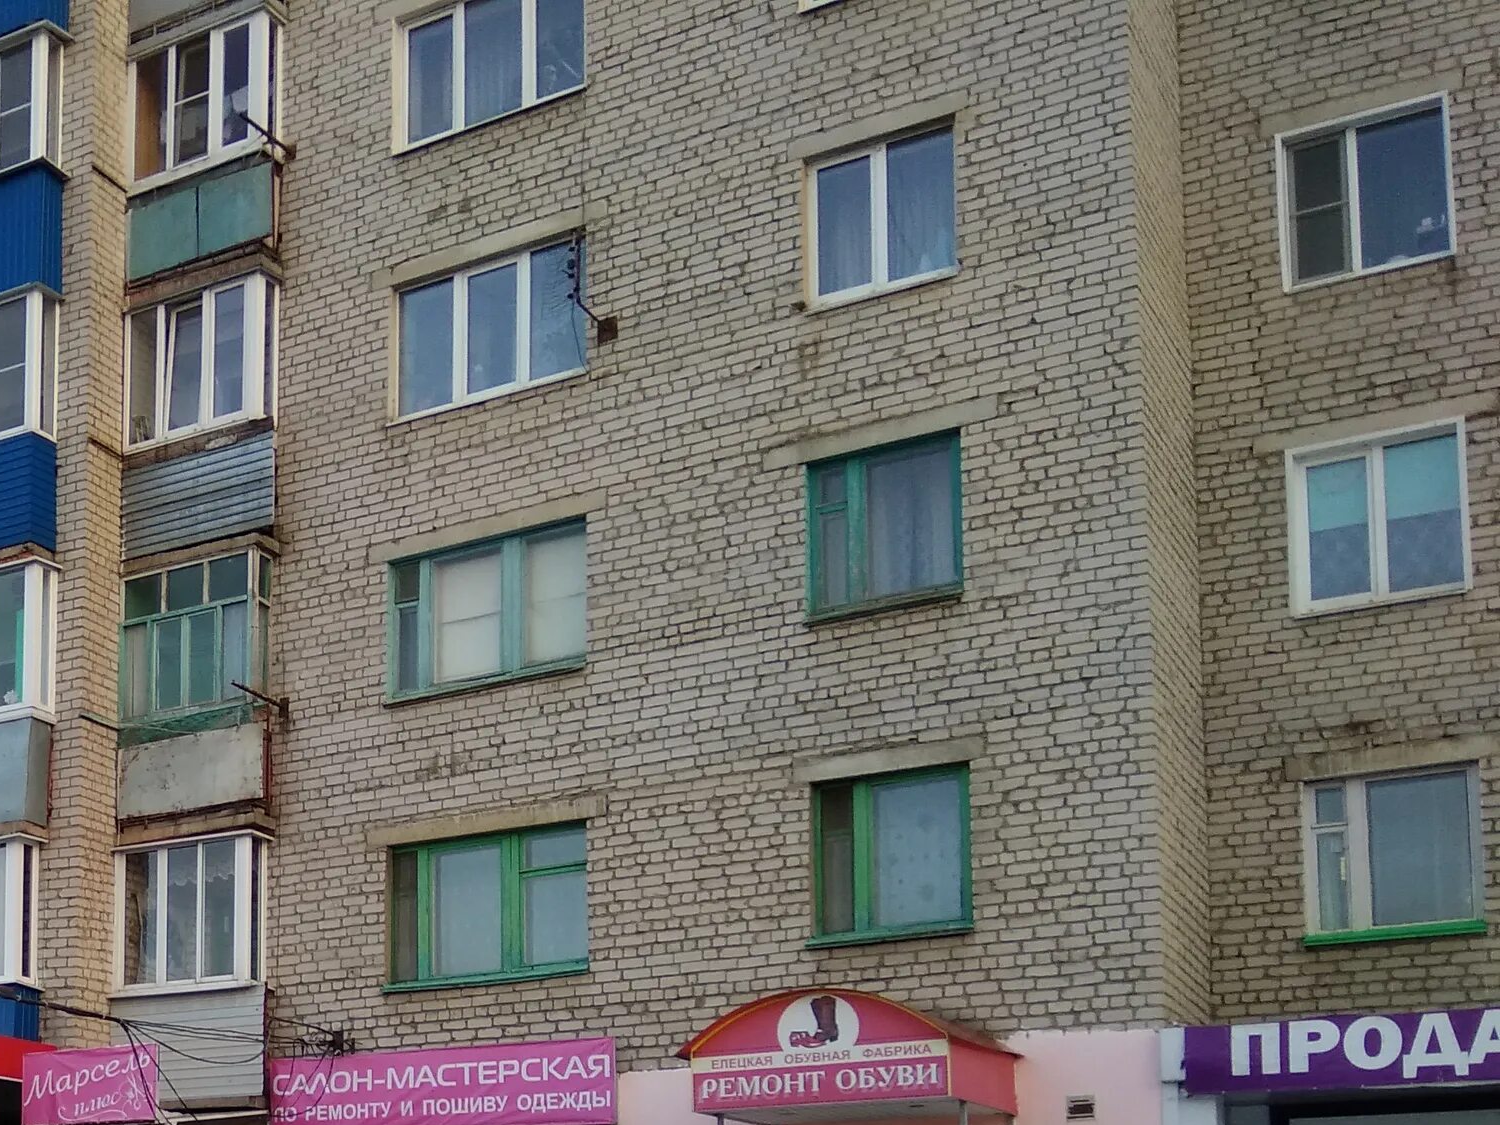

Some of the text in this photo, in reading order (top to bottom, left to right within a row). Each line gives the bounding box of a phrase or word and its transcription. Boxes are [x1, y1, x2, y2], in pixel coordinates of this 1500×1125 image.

[711, 1044, 932, 1070] ЕЛЕЦКАЯ ОБУВНАЯ ФАБРИКА
[1230, 1009, 1500, 1079] ПРОДА
[23, 1051, 151, 1107] Марсель
[273, 1054, 611, 1096] САЛОН-МАСТЕРСКАЯ
[700, 1063, 940, 1100] РЕМОНТ ОБУВИ
[73, 1093, 122, 1117] плюс
[273, 1090, 611, 1123] ПО РЕМОНТУ И ПОШИВУ ОДЕЖДЫ
